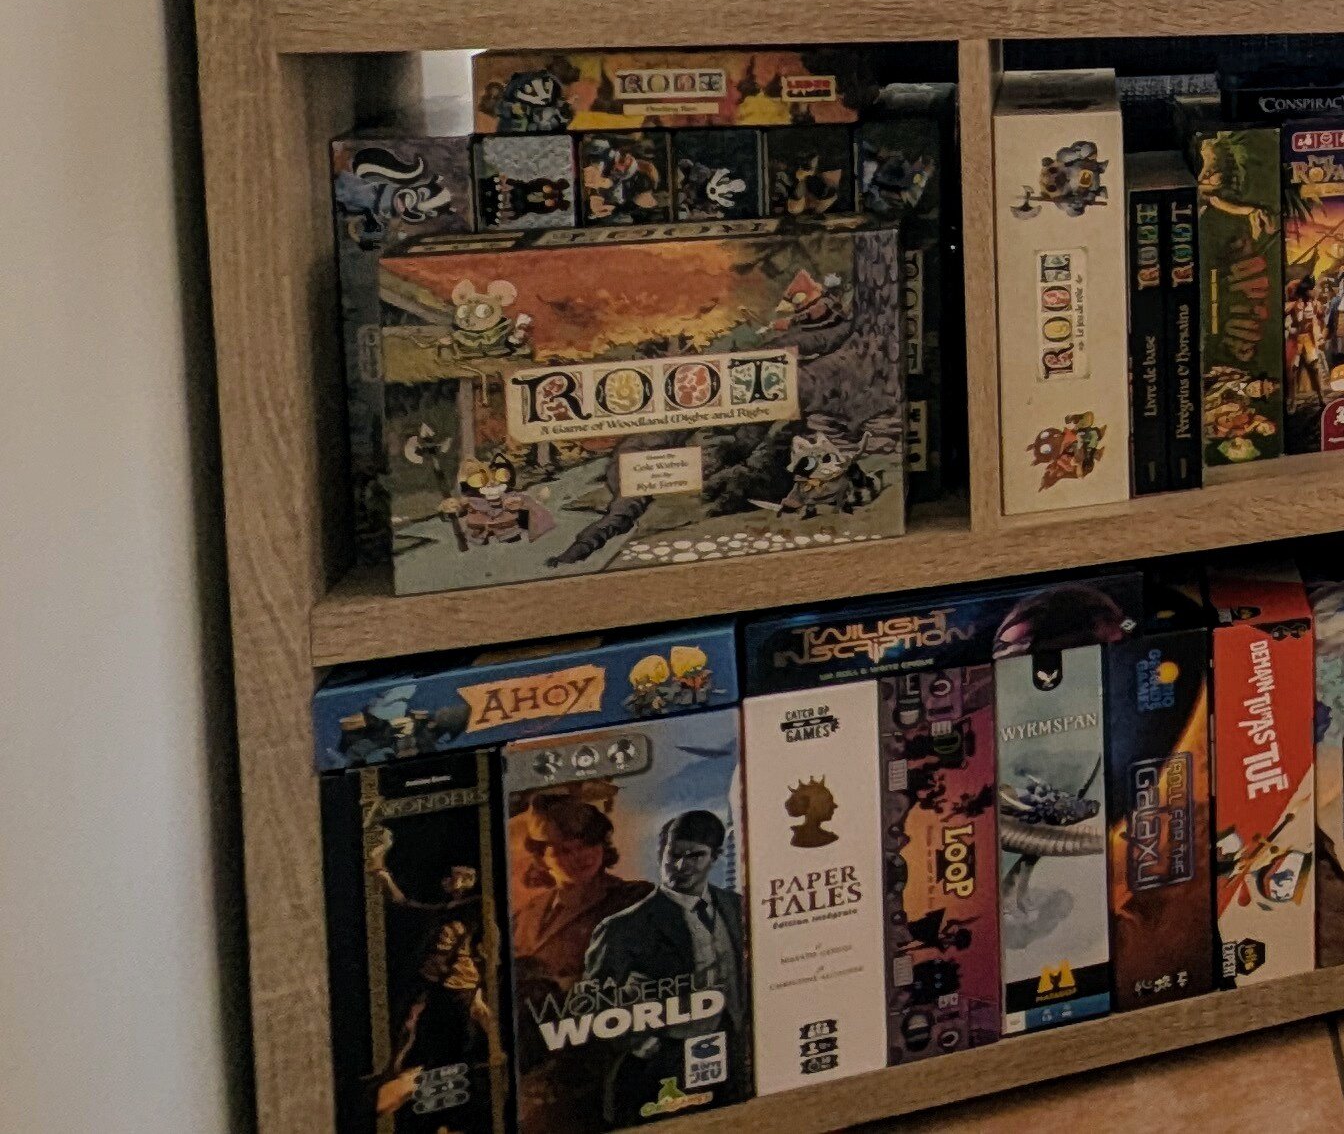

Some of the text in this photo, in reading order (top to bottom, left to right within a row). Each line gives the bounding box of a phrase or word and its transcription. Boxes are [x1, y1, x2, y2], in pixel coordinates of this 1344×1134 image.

[1171, 200, 1195, 288] ROOT
[1039, 252, 1076, 380] ROOT
[511, 353, 789, 427] ROOT
[1141, 335, 1158, 417] Livre de base
[553, 422, 588, 435] Game
[606, 414, 668, 429] Woodland
[791, 607, 957, 644] TWILIGHT
[1247, 639, 1277, 695] DEMAIN
[475, 675, 599, 726] AHOY
[785, 707, 815, 721] CATCH
[785, 724, 831, 743] GAMES
[1167, 759, 1186, 806] ROLL
[769, 864, 859, 896] PAPER
[943, 823, 974, 898] LOOP
[760, 882, 863, 920] TALES
[1221, 942, 1237, 979] EXPERT
[526, 973, 728, 1026] WONDERFUL
[539, 990, 727, 1052] WORLD
